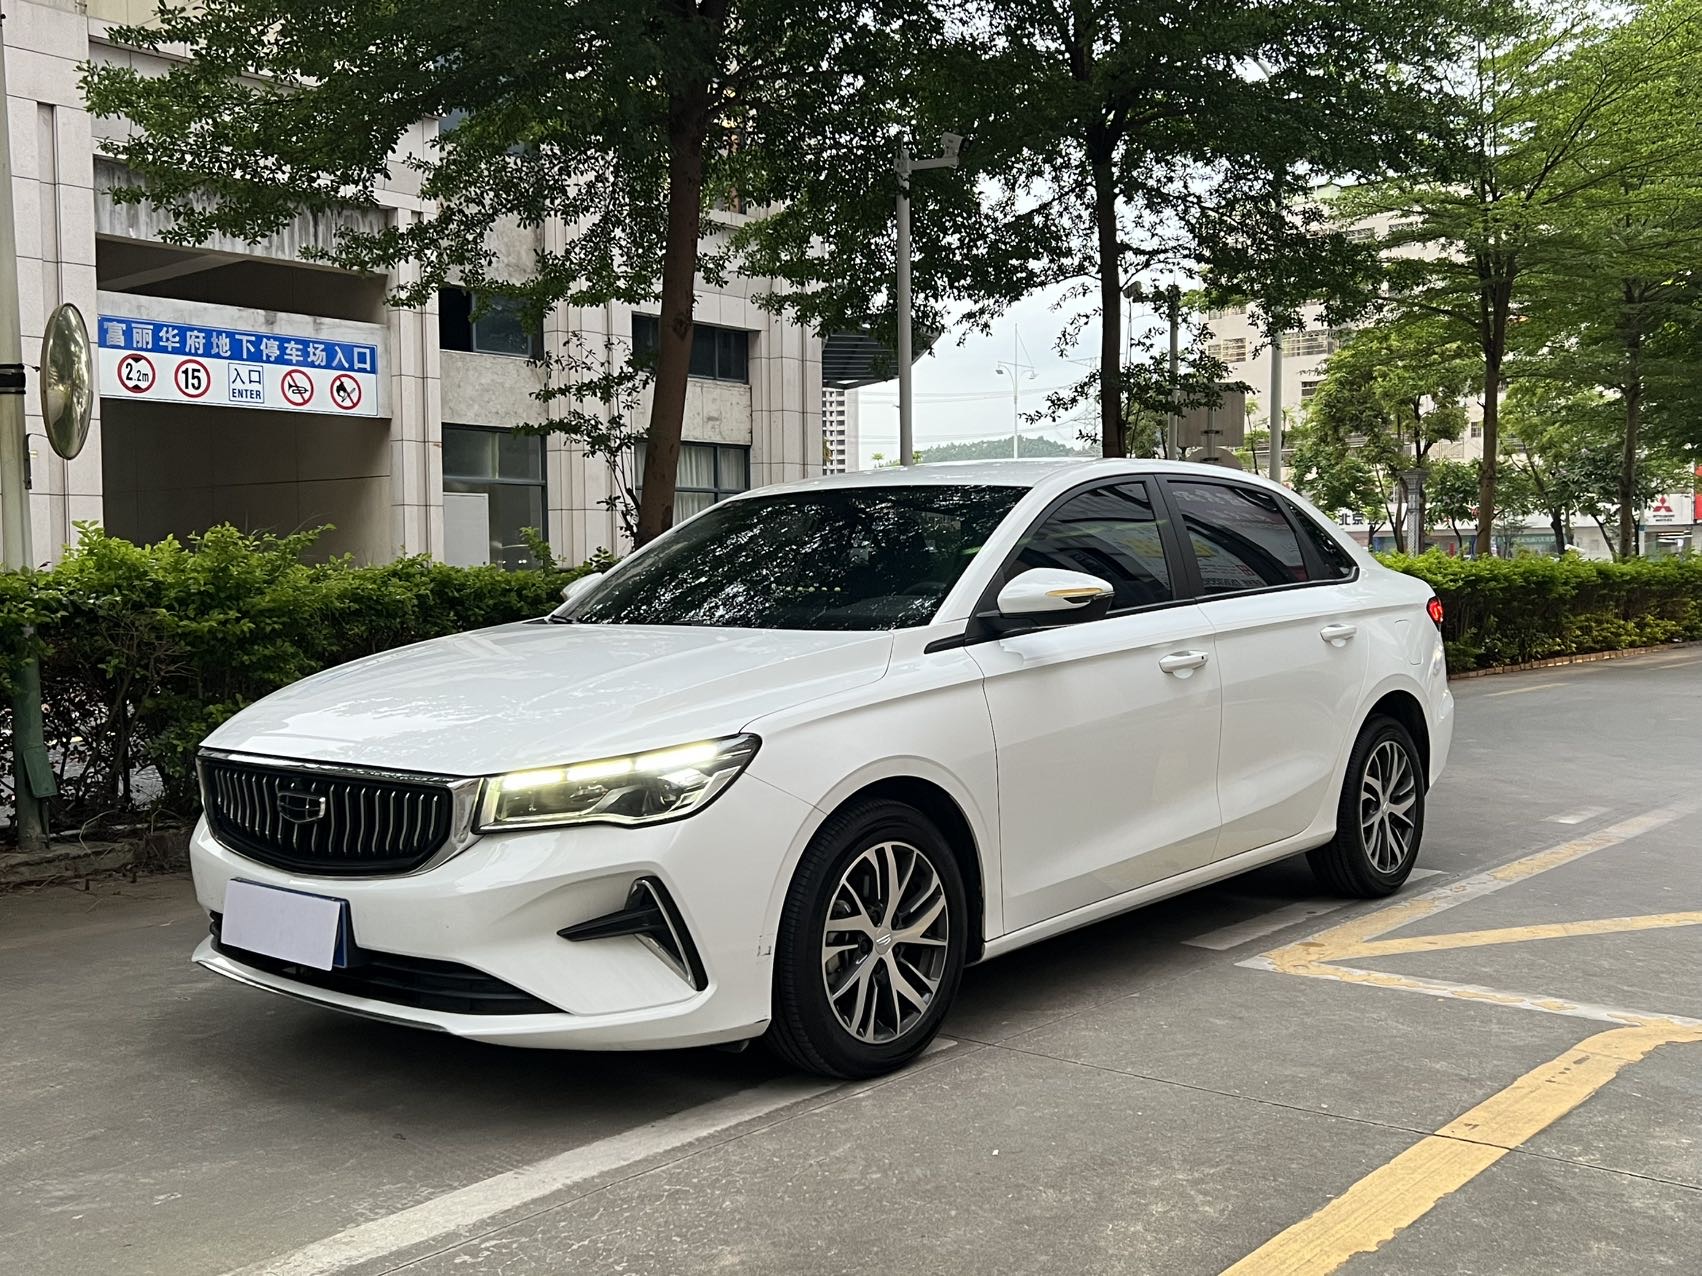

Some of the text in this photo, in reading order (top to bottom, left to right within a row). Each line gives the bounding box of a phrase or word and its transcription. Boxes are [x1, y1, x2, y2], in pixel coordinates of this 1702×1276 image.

[104, 321, 371, 371] 富丽华府地下停车场入口
[125, 362, 150, 383] 2.2m
[181, 367, 202, 391] 15
[231, 367, 262, 385] 入口
[231, 388, 262, 400] ENTER
